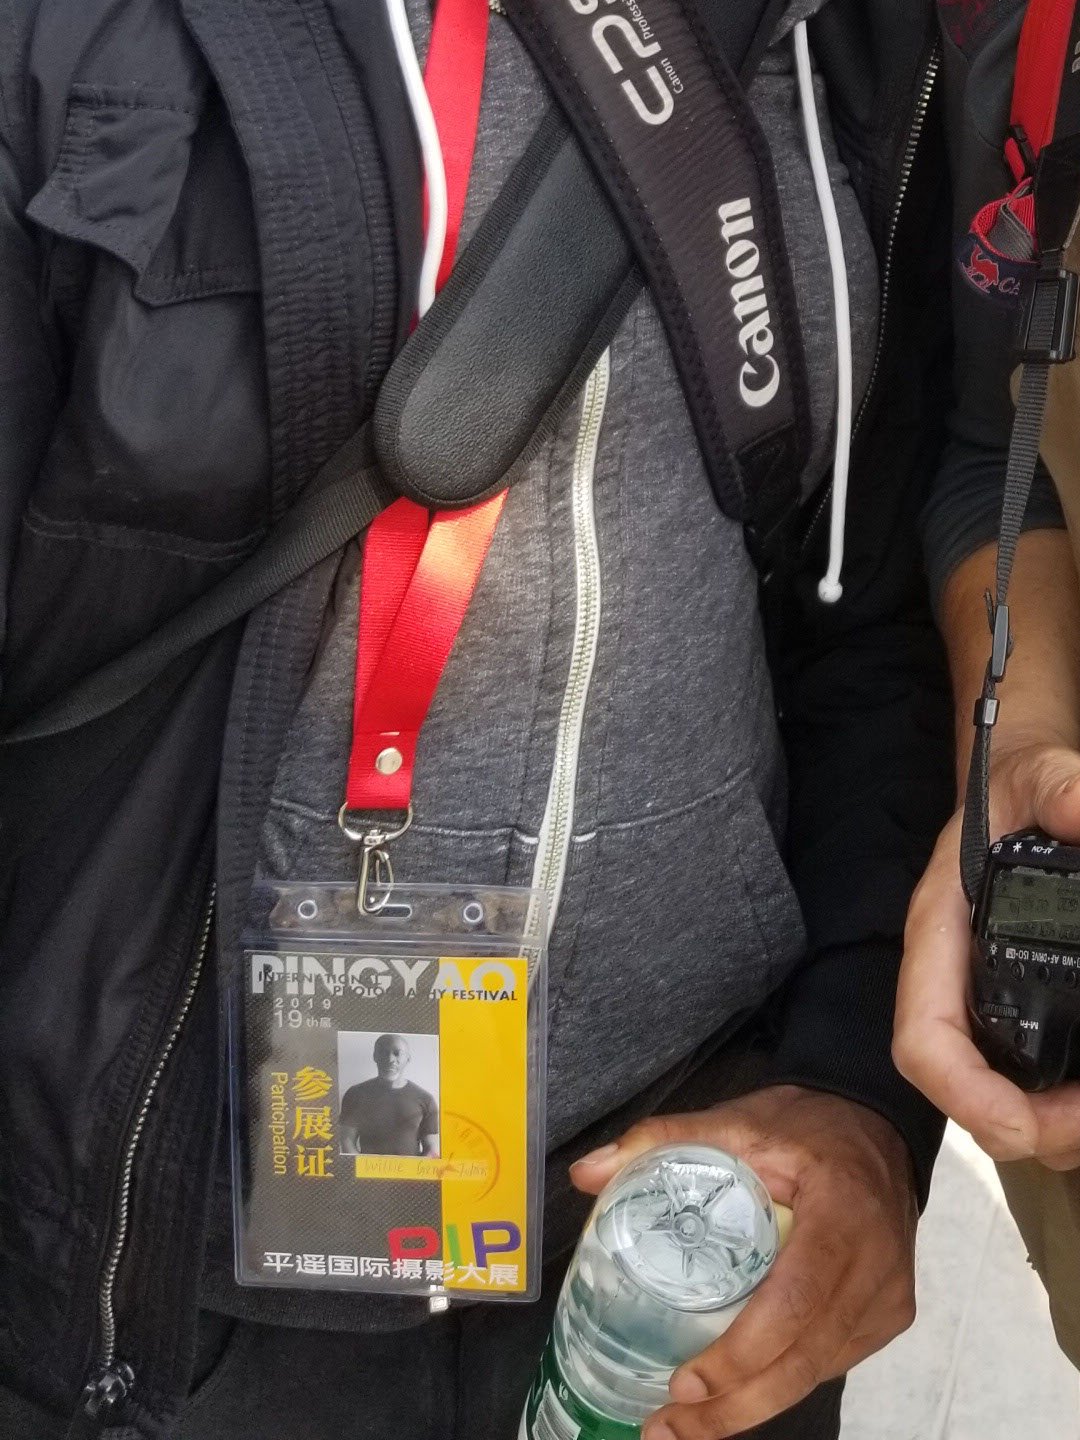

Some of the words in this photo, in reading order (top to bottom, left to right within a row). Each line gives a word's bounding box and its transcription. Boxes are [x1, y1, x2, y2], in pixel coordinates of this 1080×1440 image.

[661, 57, 684, 94] Canon
[716, 197, 781, 409] Canon
[251, 955, 515, 998] PINGYAO
[452, 989, 517, 1001] FESTIVAL
[275, 998, 332, 1009] 2019
[1020, 1019, 1039, 1030] M-Fn
[270, 1072, 288, 1175] Participation
[292, 1065, 334, 1179] 参展证
[387, 1220, 522, 1268] PIP
[263, 1251, 519, 1286] 平遥国际摄影大展
